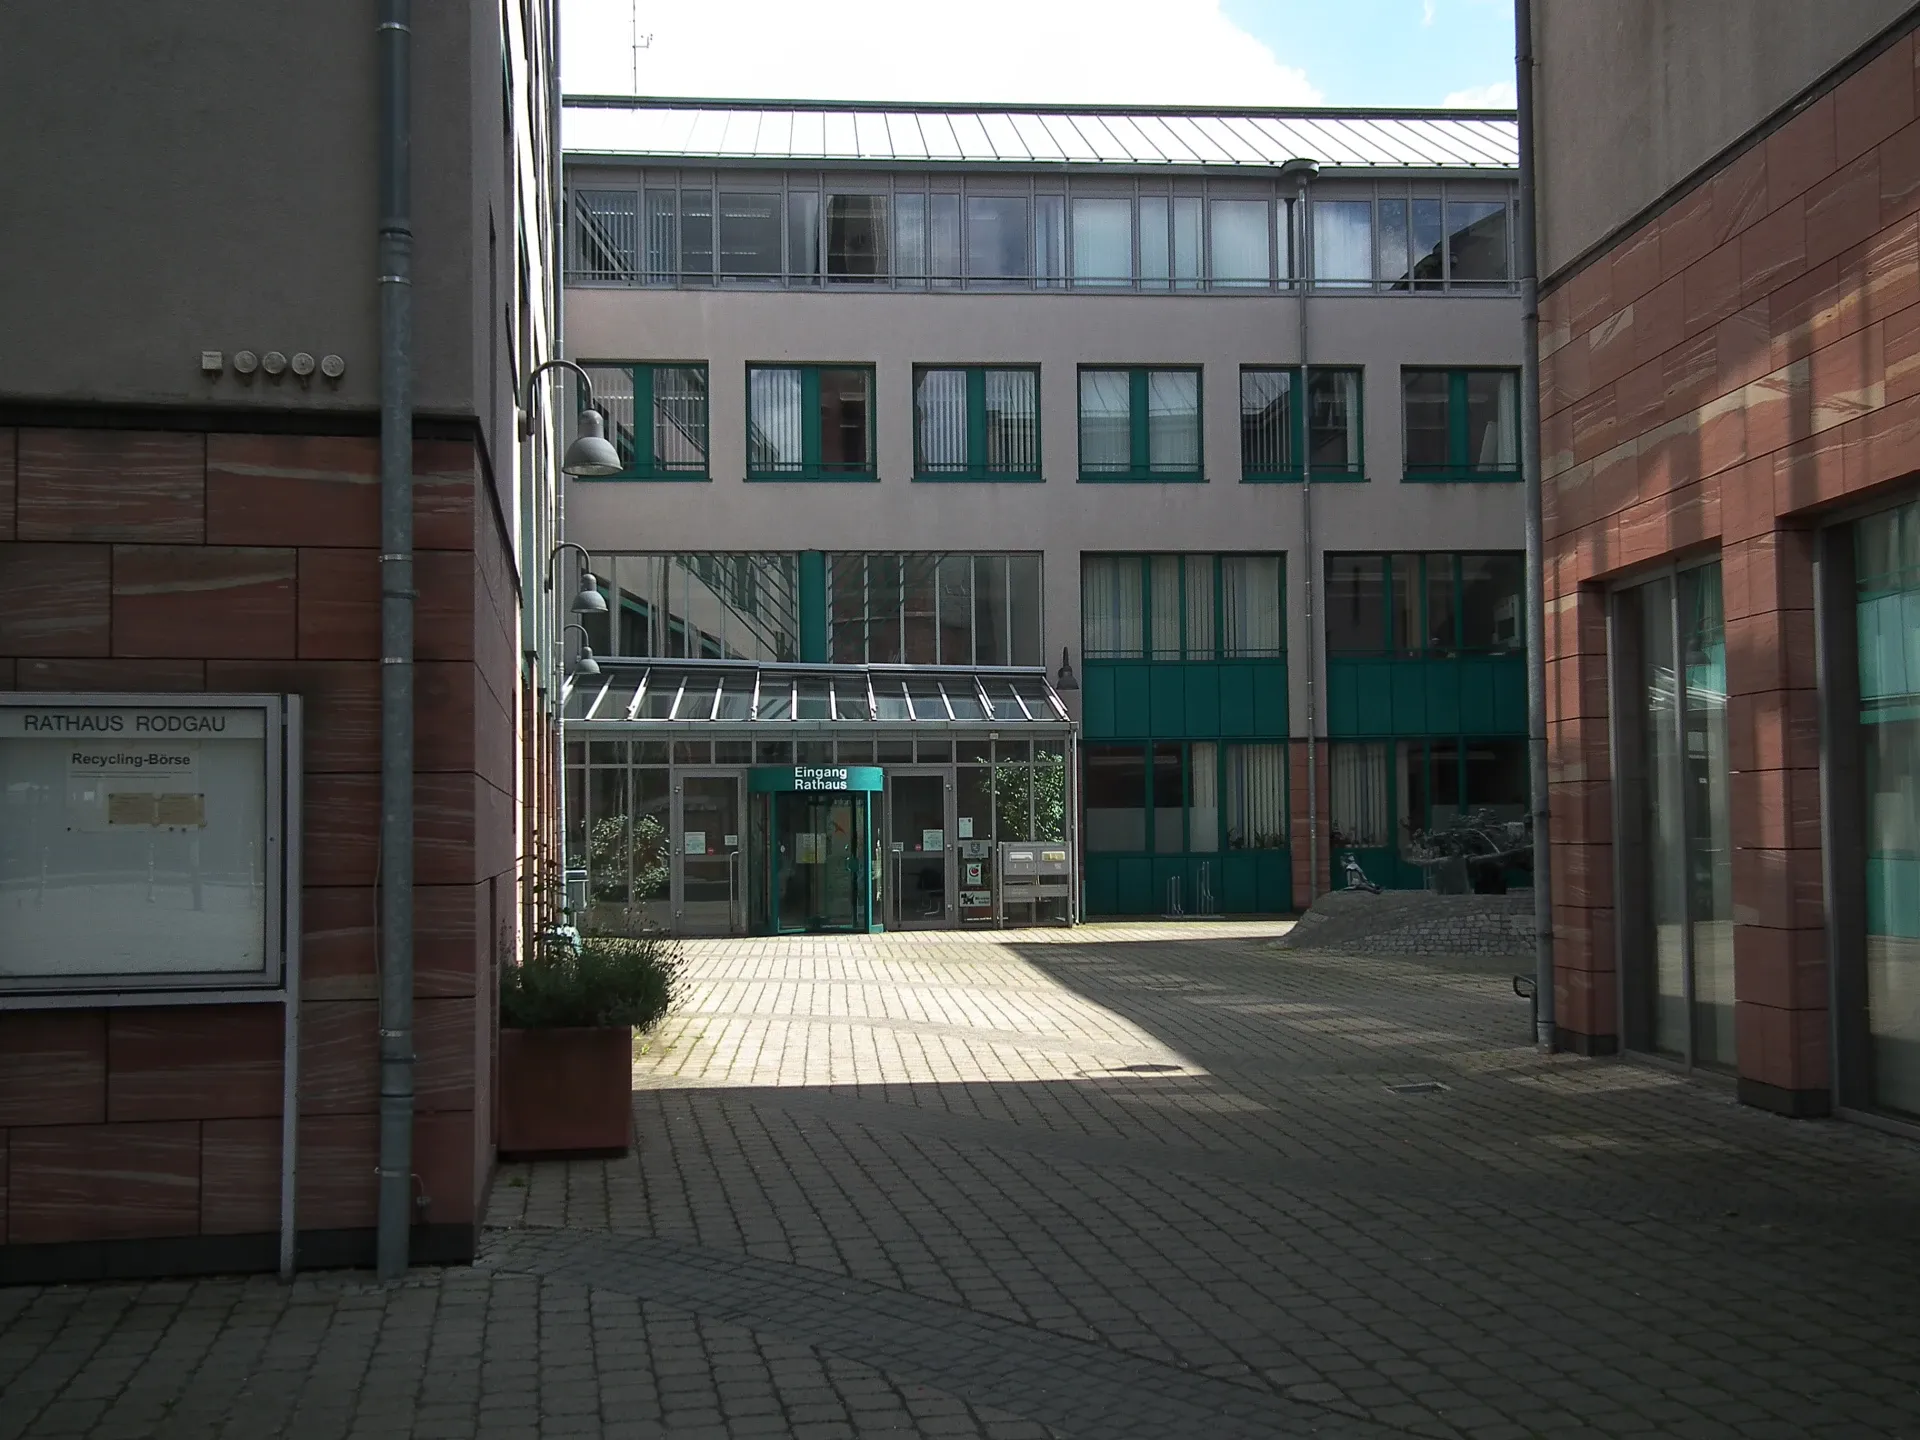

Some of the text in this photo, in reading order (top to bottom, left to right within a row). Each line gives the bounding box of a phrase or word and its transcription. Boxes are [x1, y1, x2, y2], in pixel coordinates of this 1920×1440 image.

[24, 715, 226, 732] RATHAUS RODGAU
[71, 752, 191, 768] Recycling-Börse
[794, 766, 848, 780] Eingang
[794, 779, 848, 790] Rathaus
